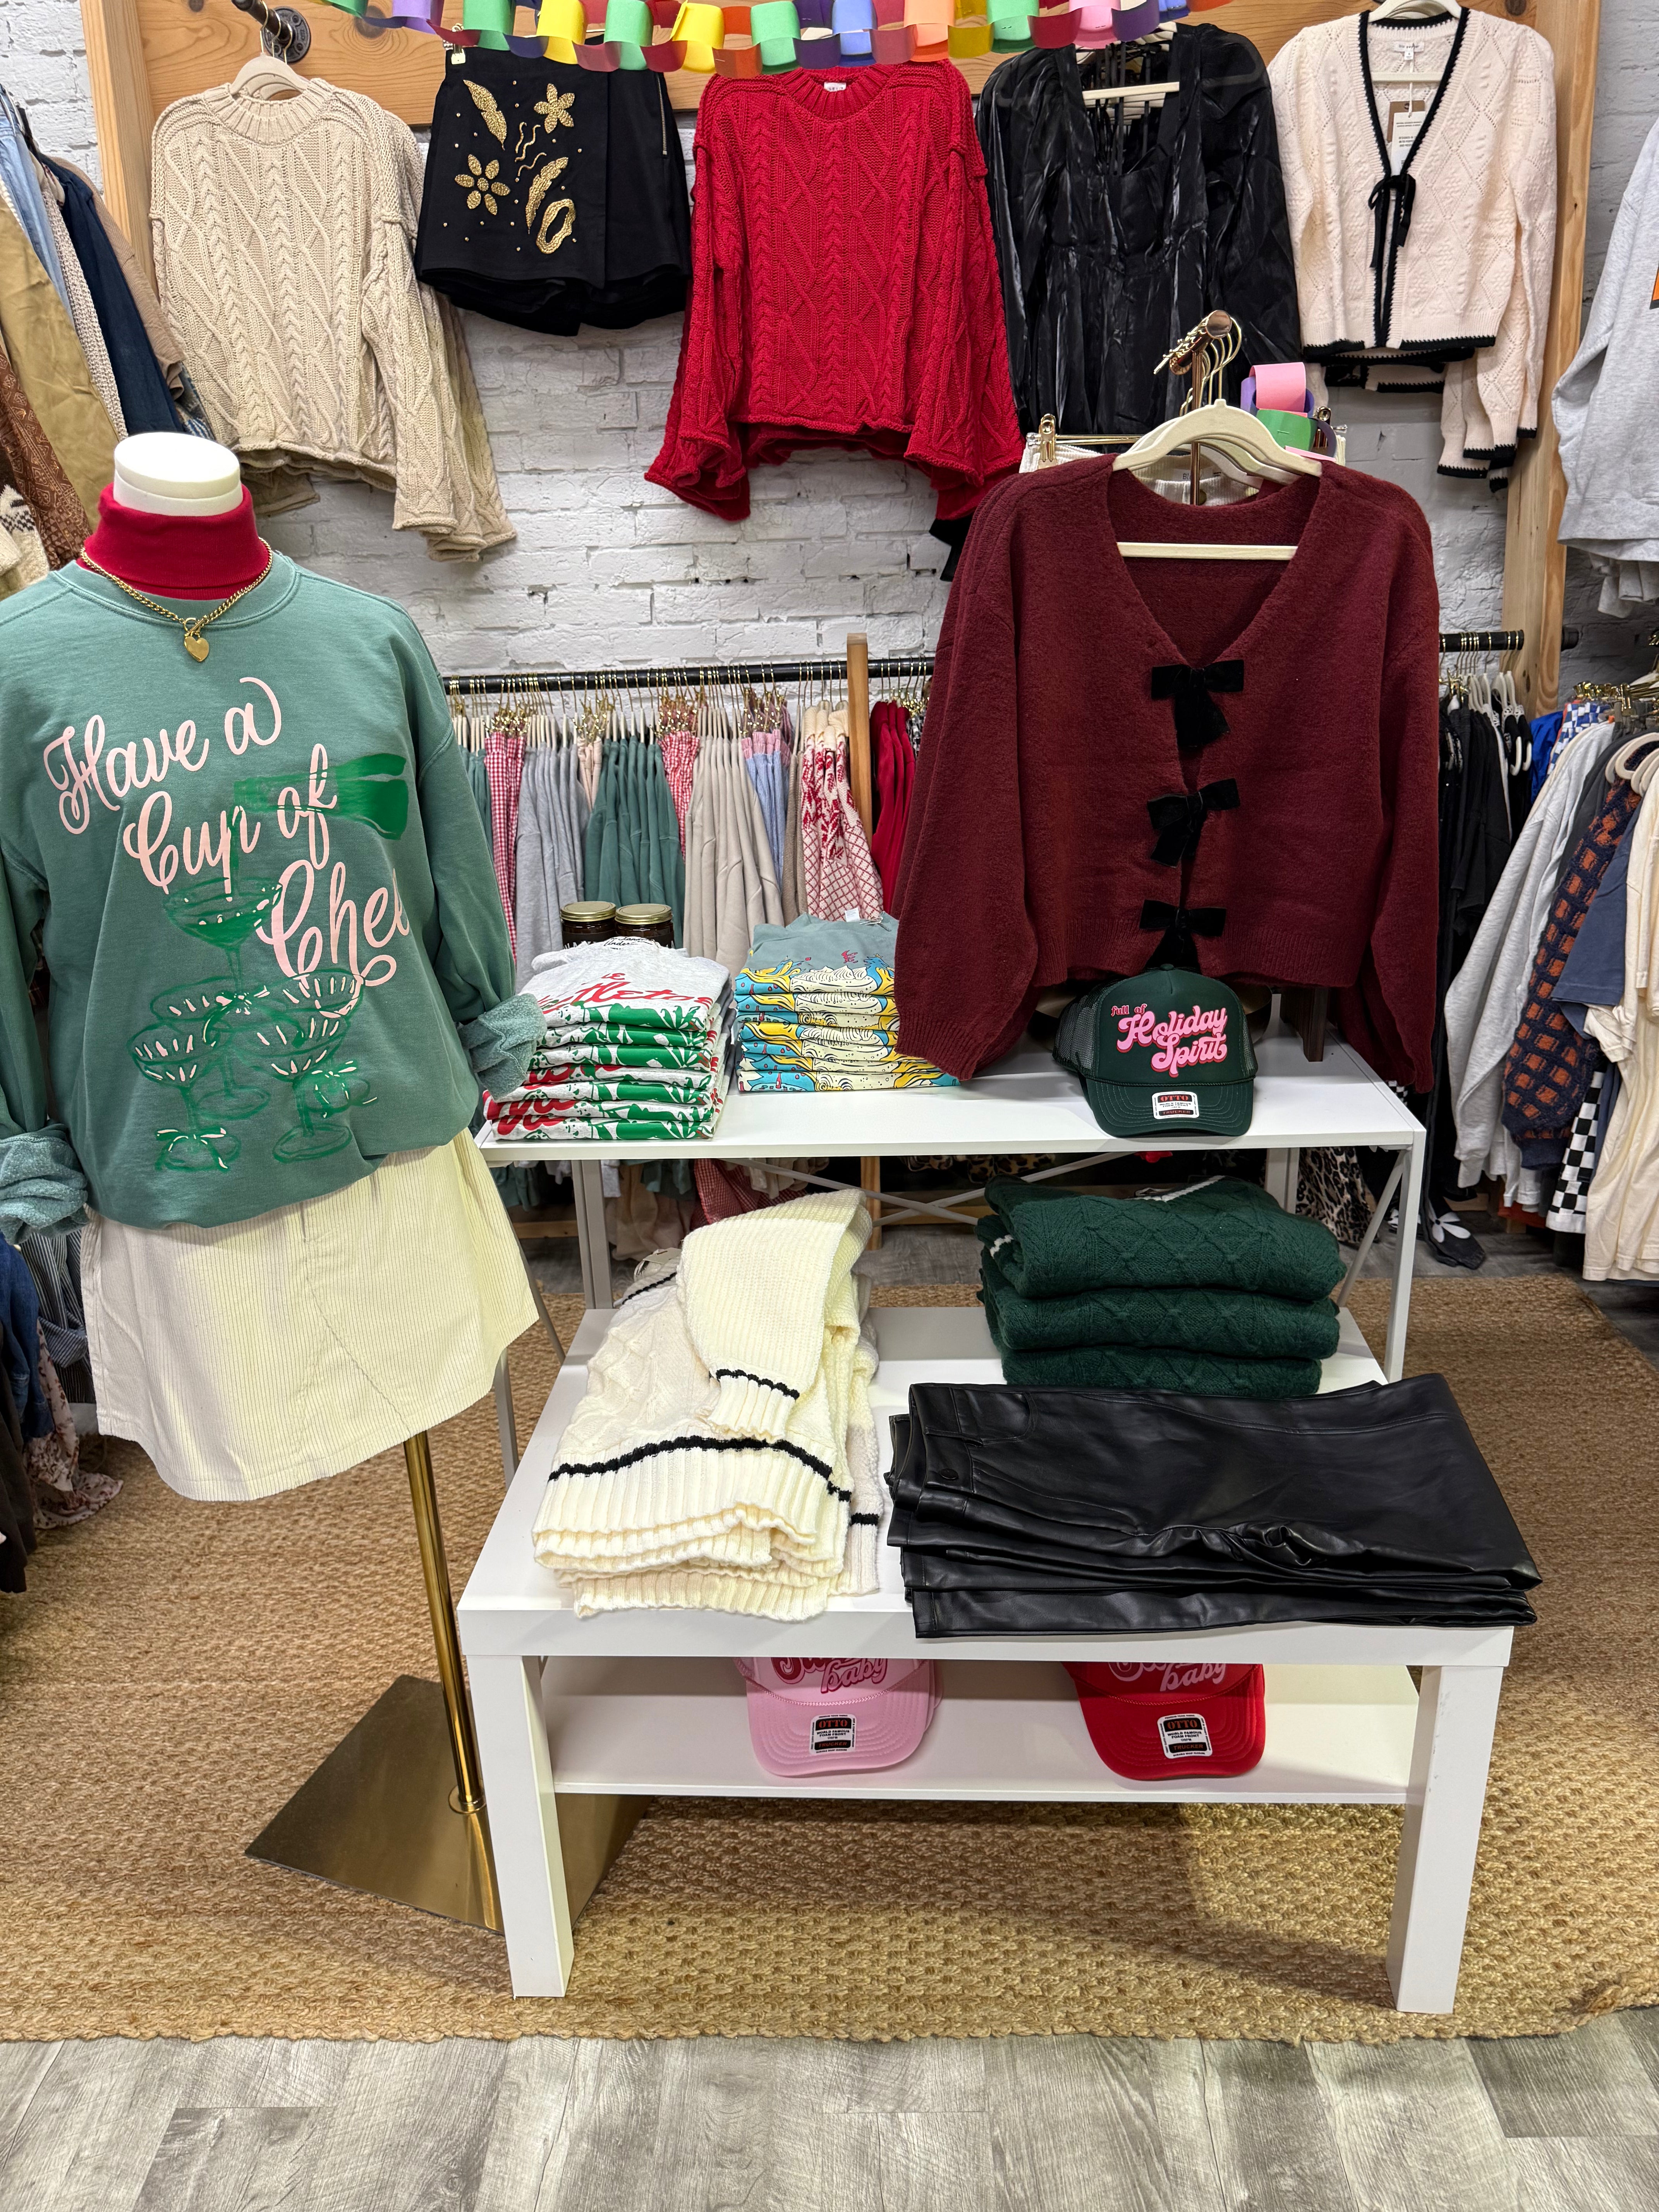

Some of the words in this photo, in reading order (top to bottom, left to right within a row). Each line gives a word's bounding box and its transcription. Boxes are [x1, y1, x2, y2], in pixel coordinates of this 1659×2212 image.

[43, 714, 209, 834] Have
[224, 677, 282, 755] a
[123, 791, 260, 902] Cup
[277, 744, 337, 870] of
[255, 859, 410, 991] Che
[1111, 1005, 1130, 1017] full
[1134, 1003, 1147, 1014] of
[1116, 1005, 1228, 1053] Holiday
[1151, 1033, 1228, 1078] Spirit
[820, 1658, 888, 1694] baby
[1160, 1663, 1226, 1692] baby
[819, 1719, 848, 1728] OTTO
[1167, 1720, 1197, 1729] OTTO
